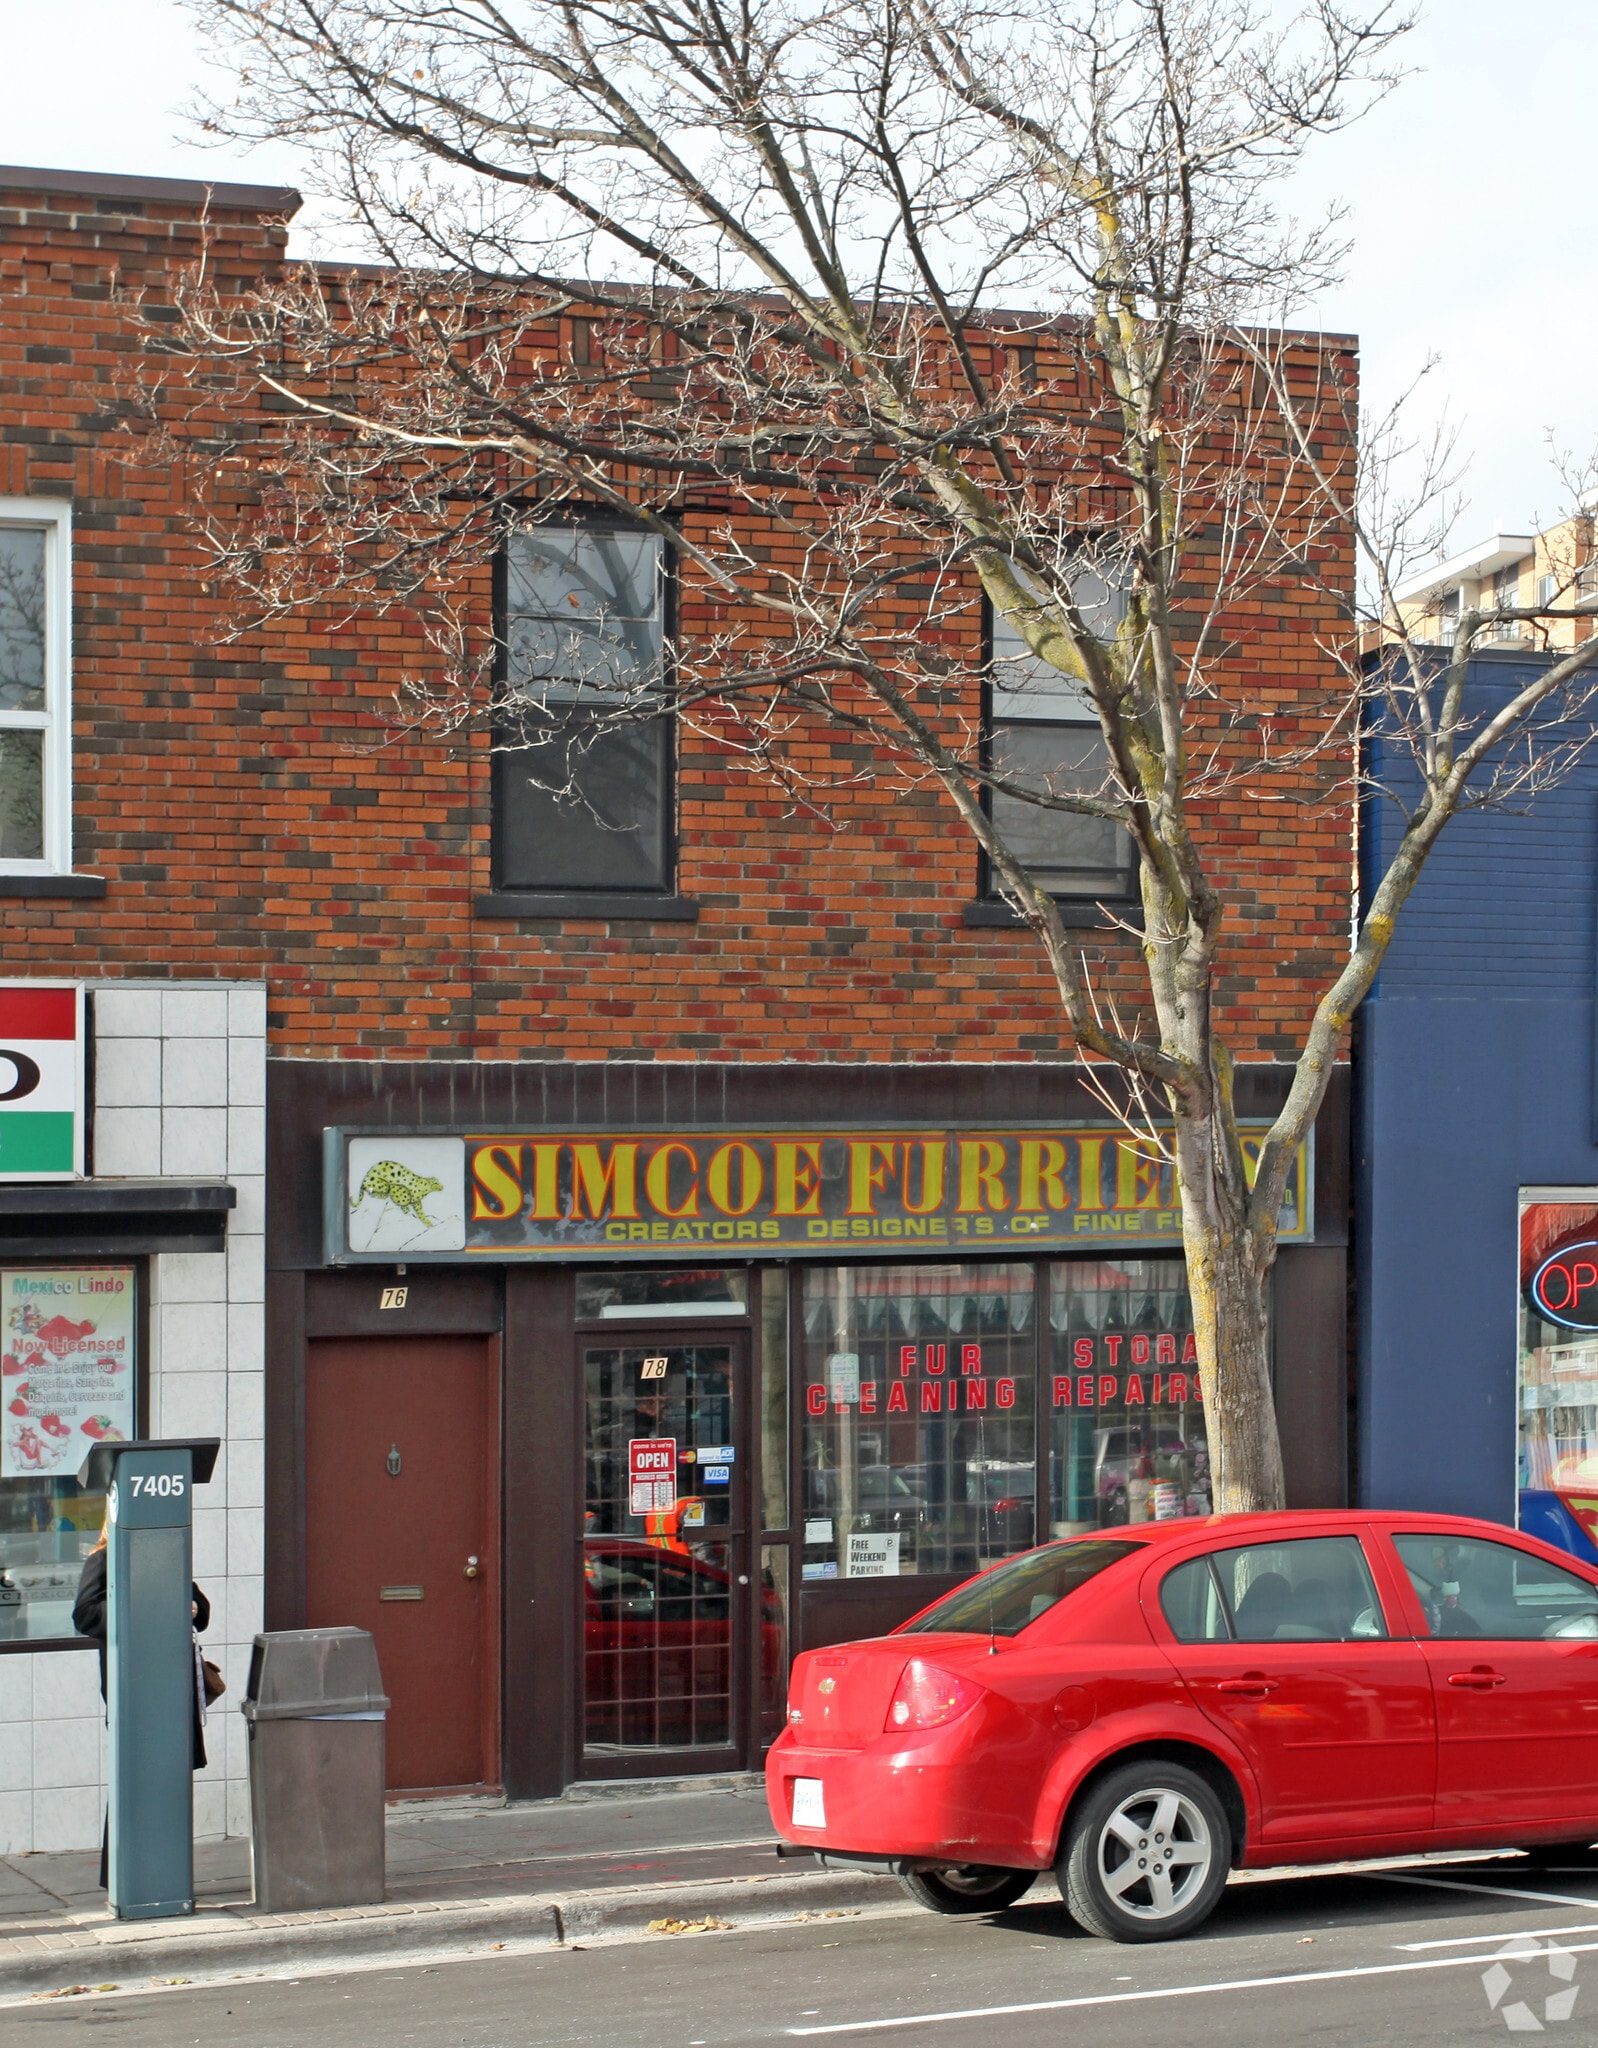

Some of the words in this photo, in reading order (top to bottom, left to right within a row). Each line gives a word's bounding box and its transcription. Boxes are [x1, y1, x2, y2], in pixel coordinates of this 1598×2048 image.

[471, 1141, 823, 1220] SIMCOE
[846, 1134, 1266, 1216] FURRIE
[605, 1220, 781, 1241] CREATORS
[1011, 1215, 1050, 1234] OF
[1073, 1212, 1142, 1232] FINE
[13, 1278, 74, 1295] Mexico
[79, 1276, 125, 1294] Lindo
[384, 1288, 405, 1308] 76
[12, 1338, 49, 1354] Now
[52, 1336, 126, 1353] Licensed
[1074, 1333, 1199, 1369] STORA
[98, 1363, 113, 1373] our
[645, 1359, 665, 1377] 78
[900, 1343, 982, 1377] FUR
[807, 1378, 1016, 1416] CLEANING
[636, 1452, 669, 1469] OPEN
[708, 1469, 728, 1478] VISA
[130, 1474, 185, 1497] 7405
[851, 1539, 869, 1550] FREE
[850, 1551, 887, 1562] WEEKEND
[850, 1564, 884, 1575] PARKING
